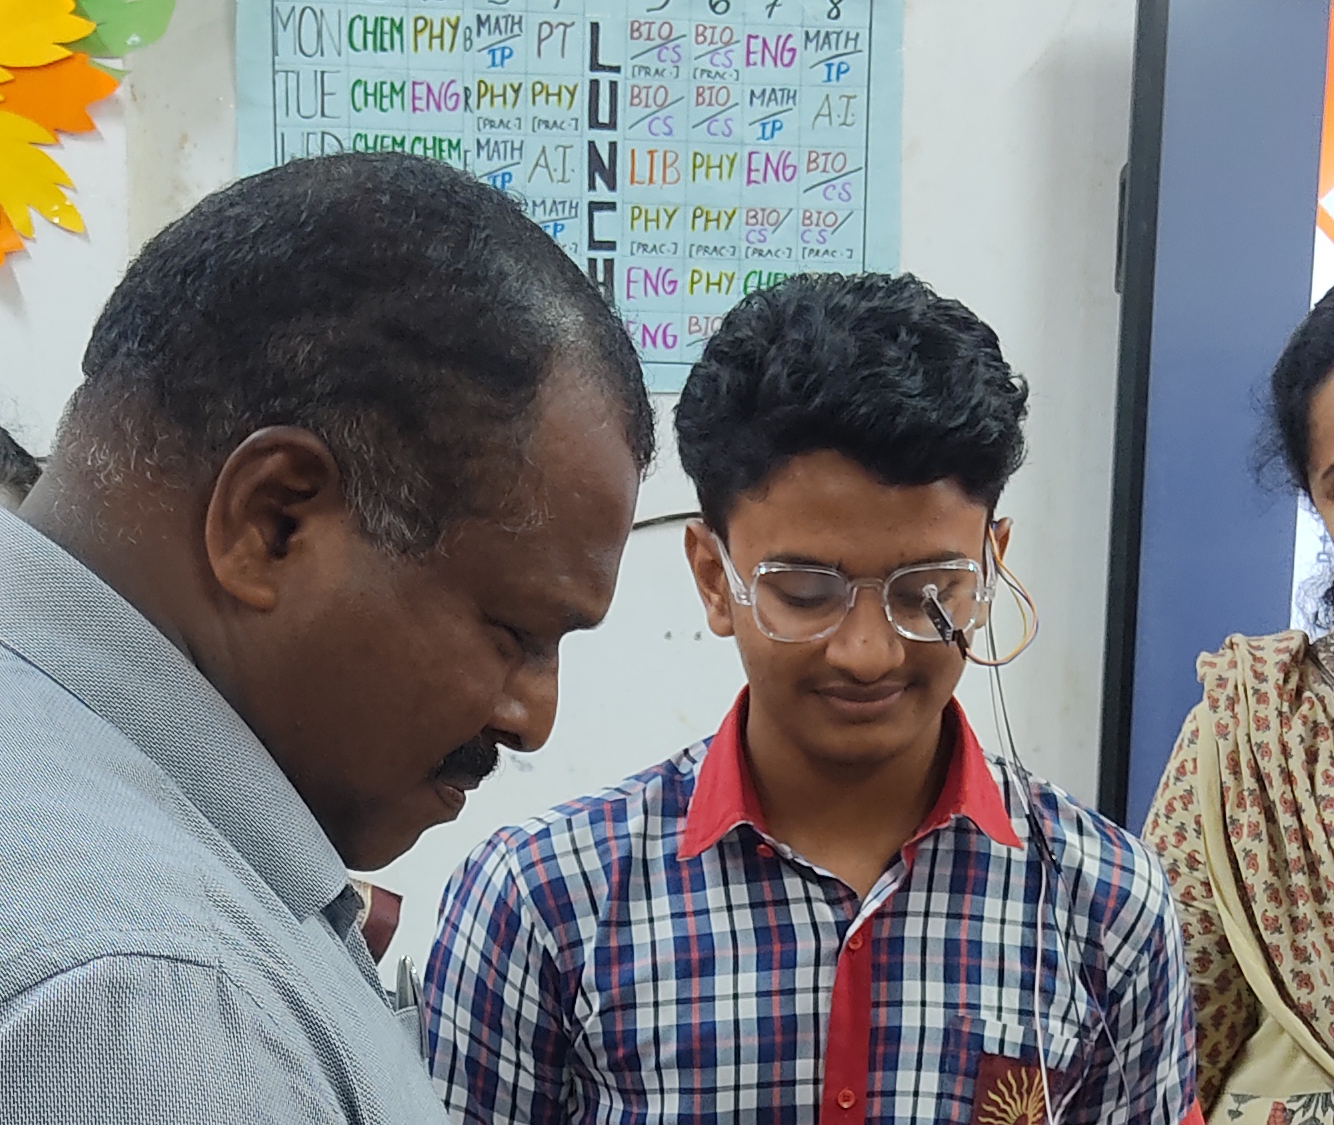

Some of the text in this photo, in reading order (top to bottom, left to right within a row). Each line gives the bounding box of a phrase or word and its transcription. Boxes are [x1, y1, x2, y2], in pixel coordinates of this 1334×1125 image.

[275, 6, 342, 57] MON
[348, 14, 405, 54] CHEM
[412, 15, 461, 53] PHY
[475, 14, 523, 38] MATH
[537, 21, 575, 59] PT
[745, 34, 797, 69] ENG
[804, 30, 860, 52] MATH
[487, 46, 514, 69] IP
[657, 45, 682, 64] CS
[710, 49, 734, 69] CS
[822, 61, 850, 83] IP
[275, 69, 342, 120] TUE
[351, 79, 406, 113] CHEM
[411, 79, 461, 114] ENG
[476, 80, 523, 110] PHY
[531, 81, 579, 110] PHY
[749, 88, 797, 107] MATH
[648, 116, 674, 137] CS
[706, 117, 734, 138] CS
[756, 119, 784, 141] IP
[476, 138, 524, 161] MATH
[629, 148, 681, 189] LIB
[692, 151, 738, 183] PHY
[746, 150, 797, 187] ENG
[822, 182, 852, 202] CS
[533, 200, 579, 218] MATH
[630, 206, 679, 232] PHY
[691, 206, 737, 232] PHY
[745, 229, 768, 245] CS
[800, 229, 827, 244] CS
[626, 267, 678, 300] ENG
[689, 268, 735, 296] PHY
